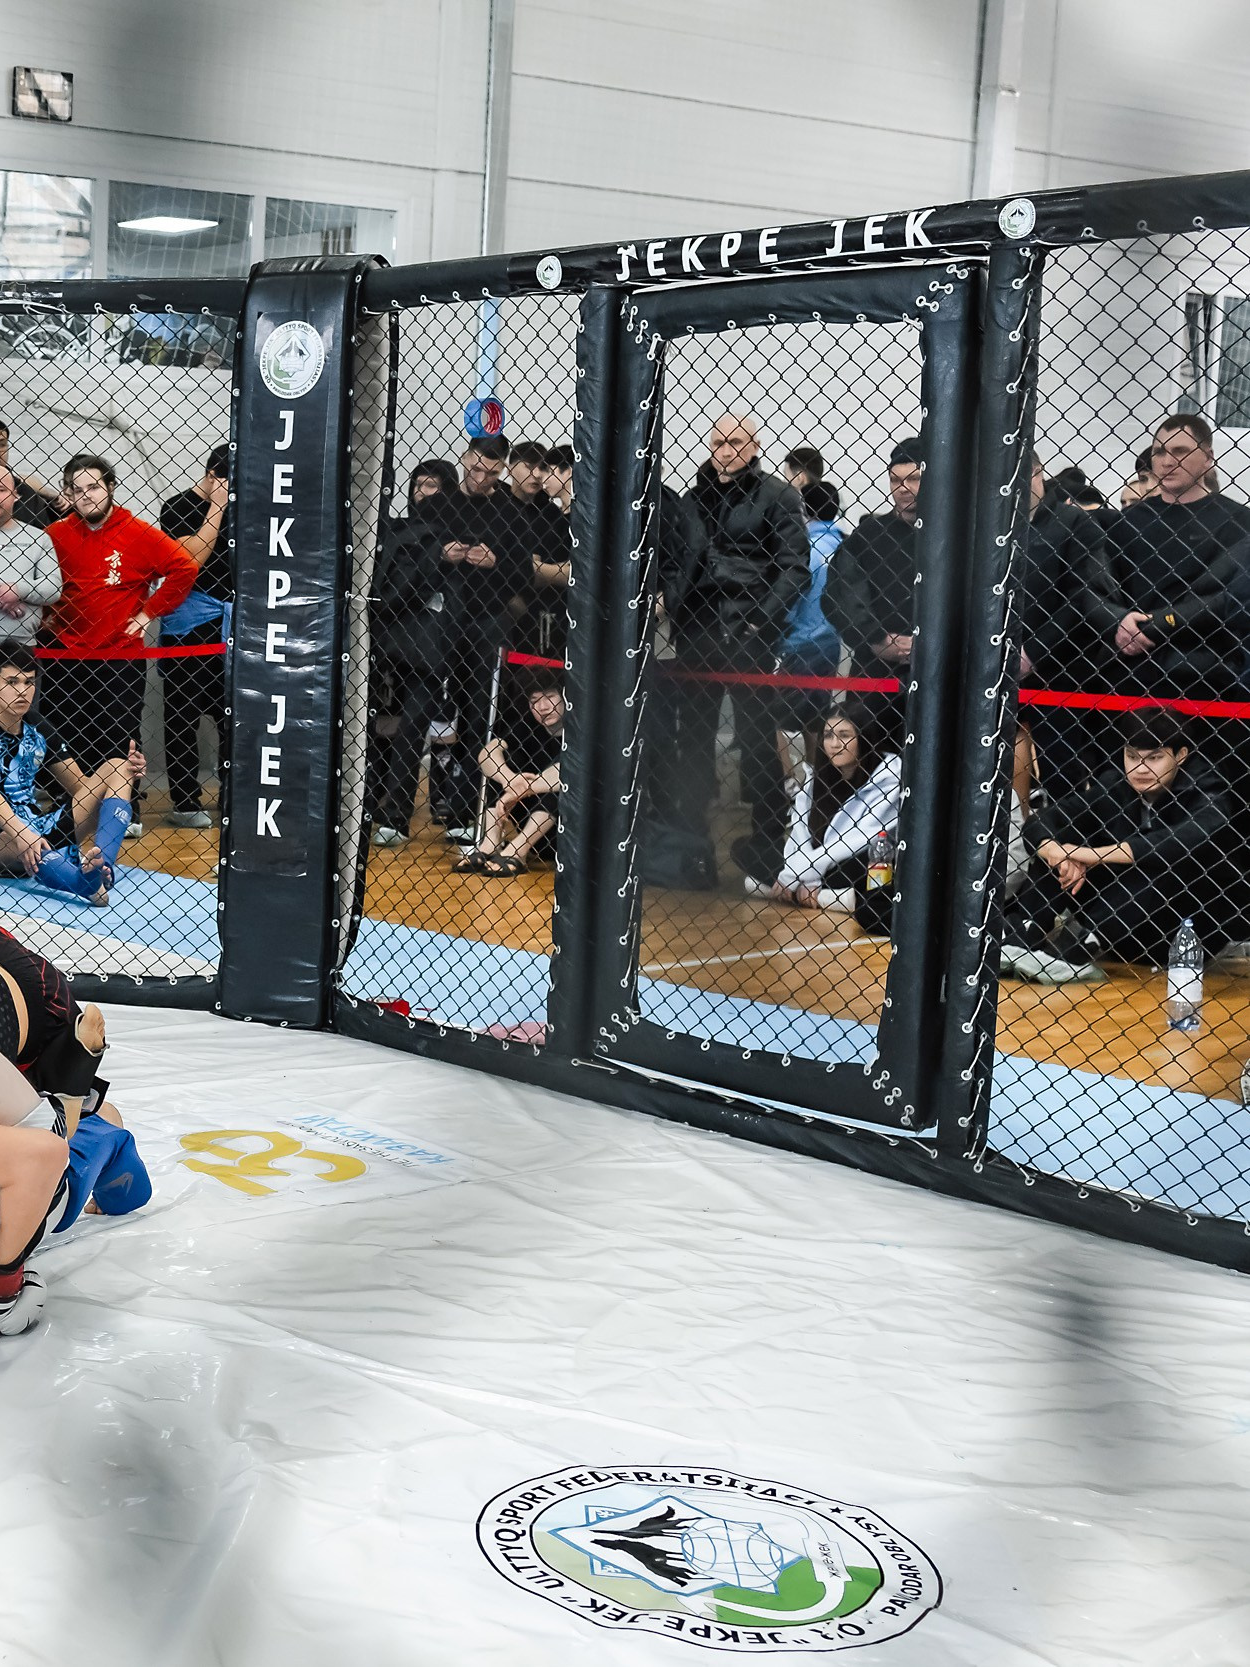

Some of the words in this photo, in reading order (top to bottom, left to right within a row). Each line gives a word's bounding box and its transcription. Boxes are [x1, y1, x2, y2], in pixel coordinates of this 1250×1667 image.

[615, 227, 782, 282] JEKPE
[825, 208, 937, 256] JEK
[265, 409, 295, 663] JEKPE
[256, 694, 287, 838] JEK
[495, 1484, 557, 1526] SPORT
[494, 1527, 565, 1589] ULTTYQ
